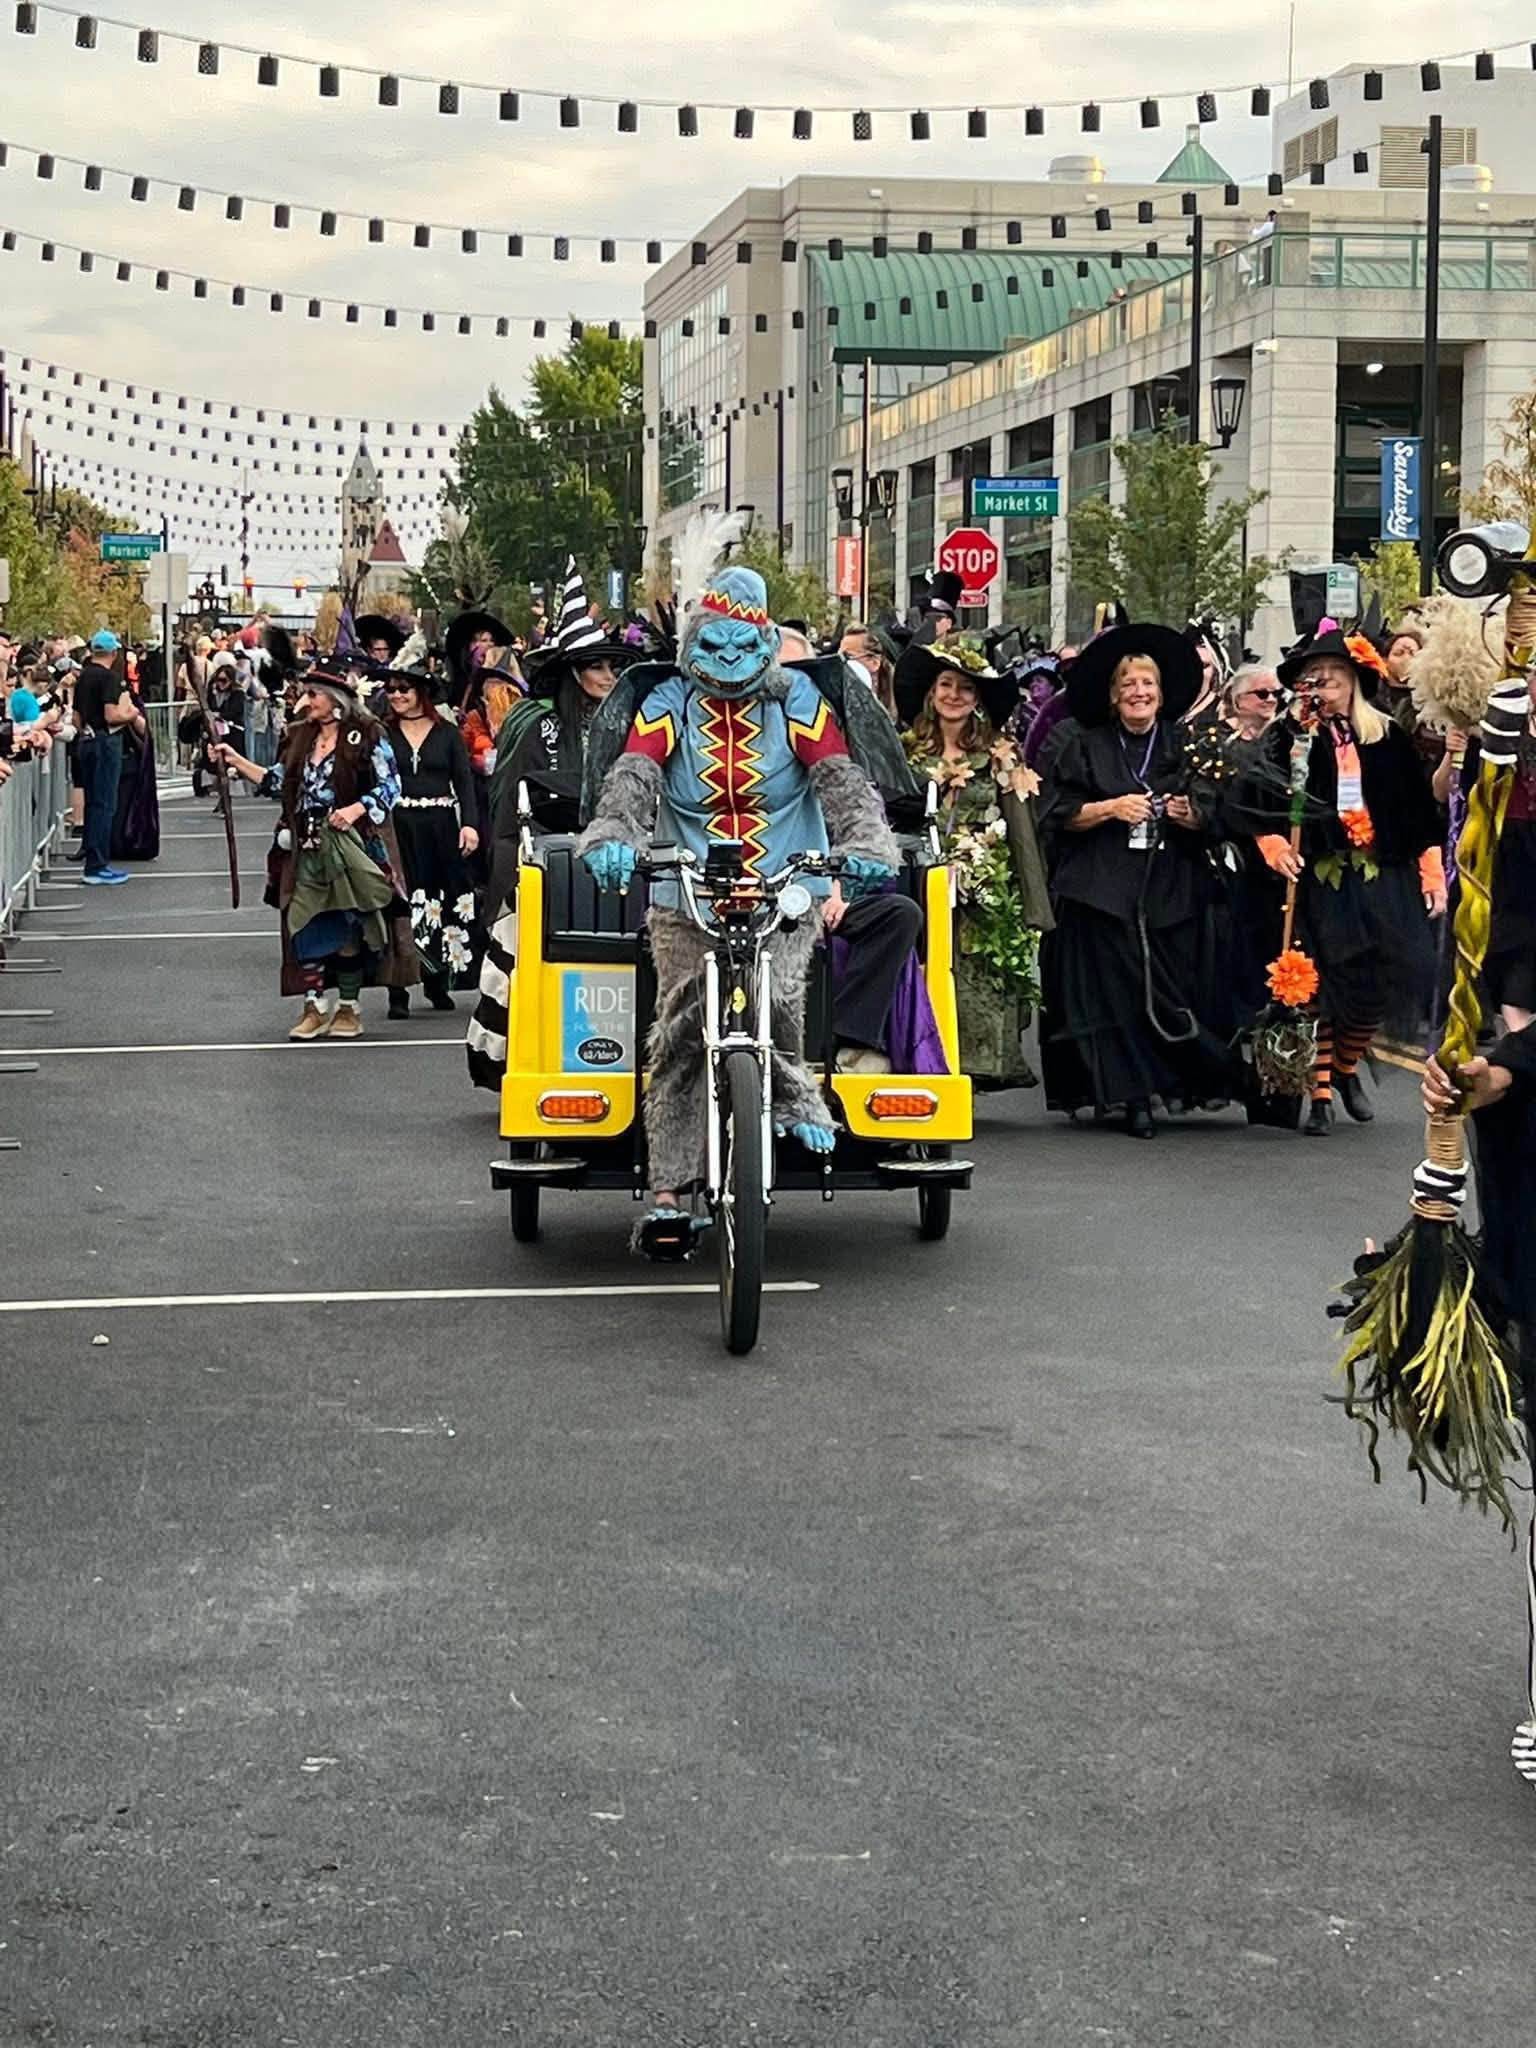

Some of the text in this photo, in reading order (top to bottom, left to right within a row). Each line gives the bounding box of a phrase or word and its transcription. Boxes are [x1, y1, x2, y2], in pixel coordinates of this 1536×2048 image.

[1387, 440, 1414, 538] Sandusky
[984, 495, 1048, 511] Market St
[109, 545, 141, 557] Market
[942, 548, 996, 573] STOP
[575, 986, 631, 1013] RIDE
